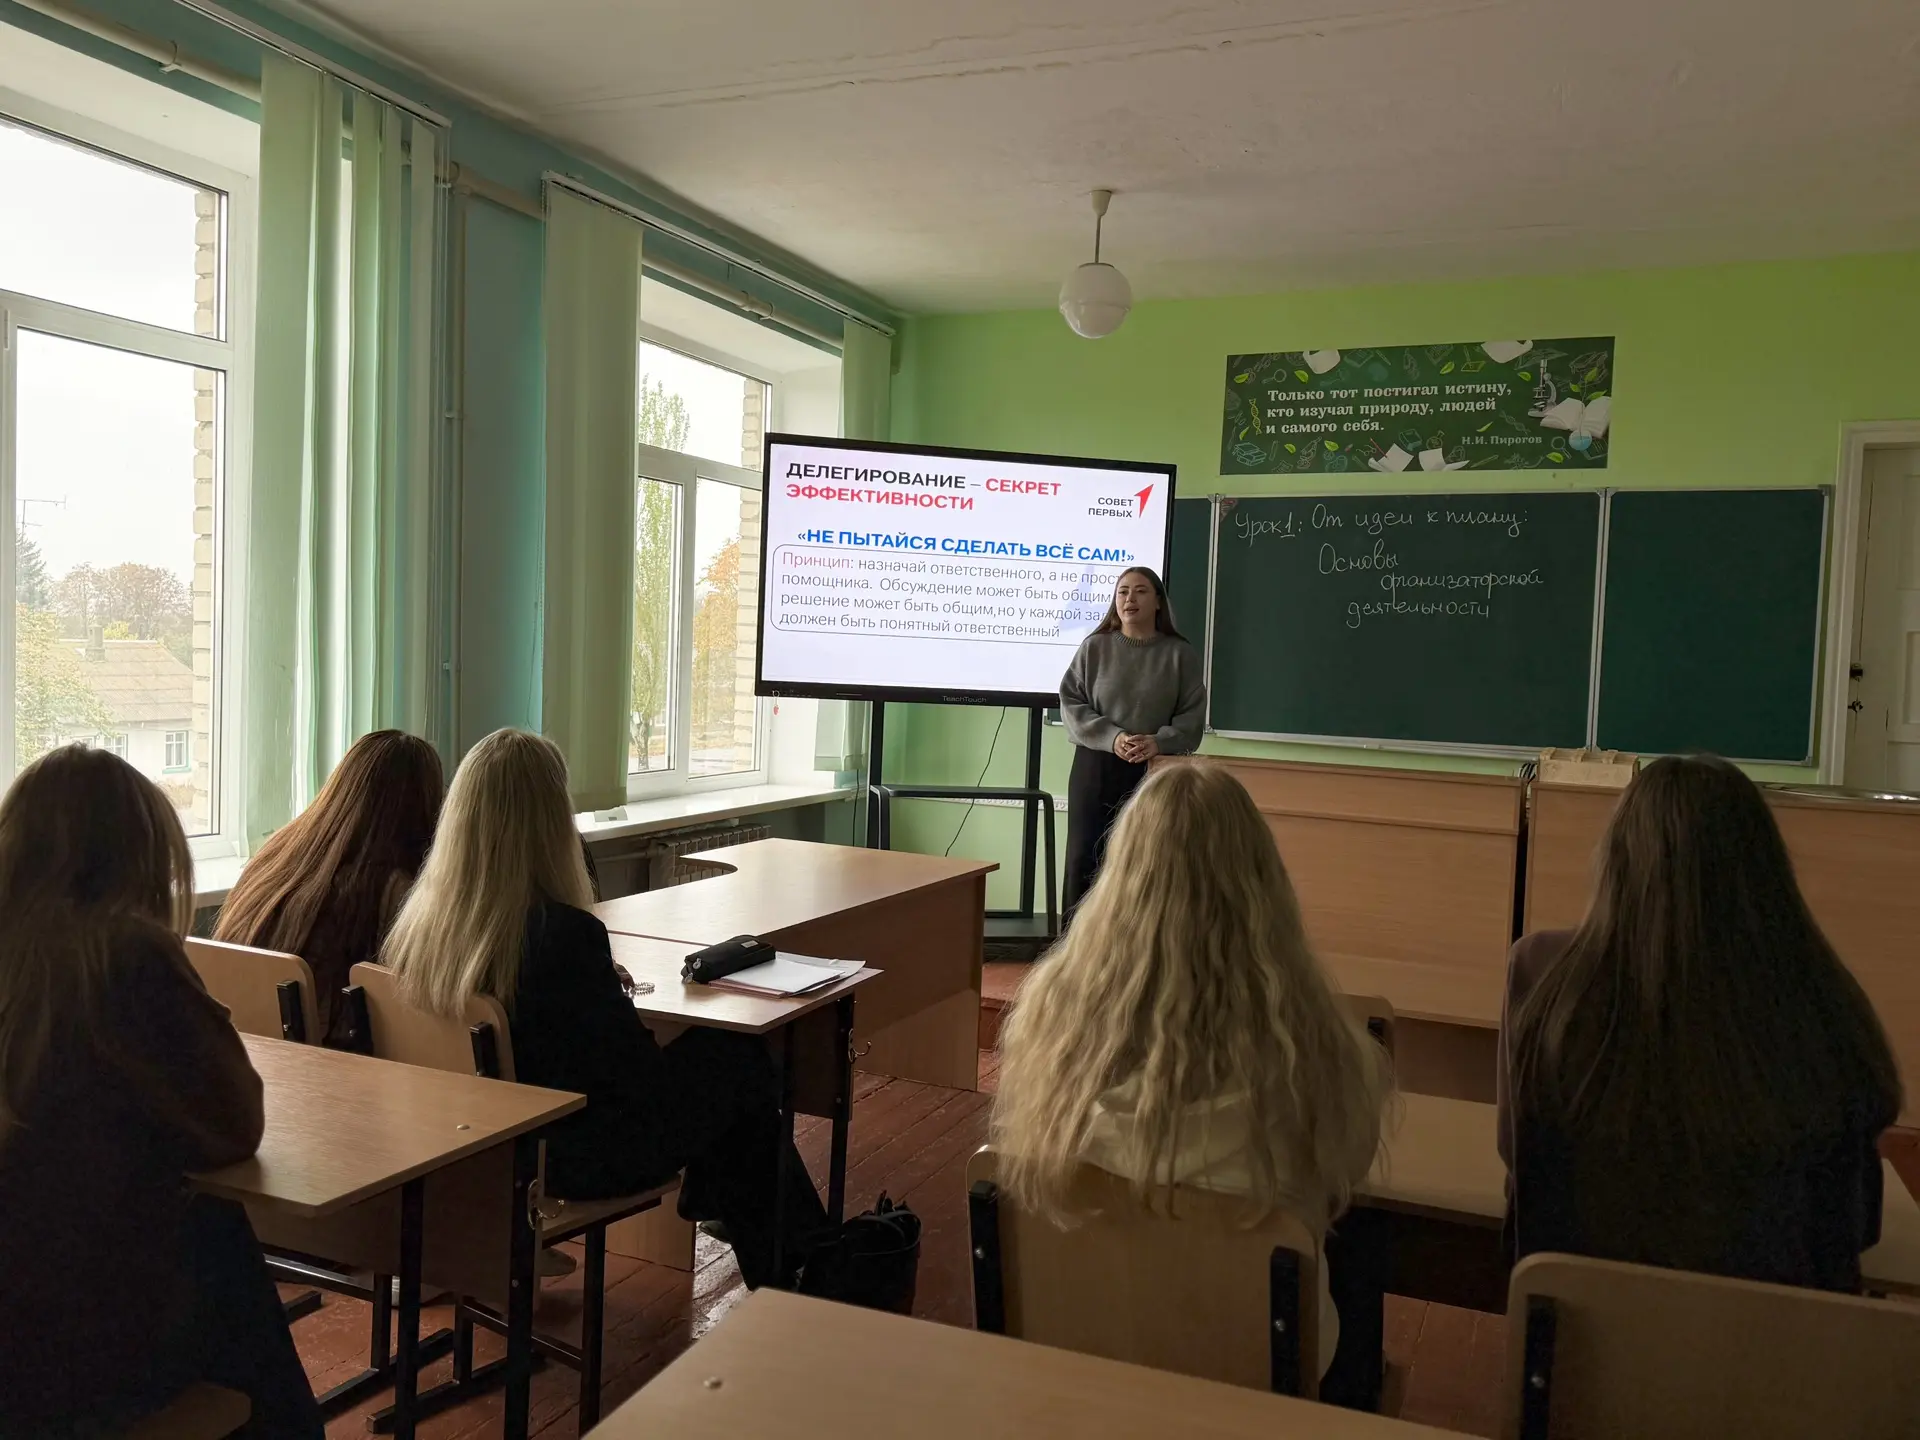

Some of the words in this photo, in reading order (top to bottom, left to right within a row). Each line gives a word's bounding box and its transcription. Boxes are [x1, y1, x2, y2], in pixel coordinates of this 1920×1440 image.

[1268, 389, 1325, 402] Только
[1330, 388, 1358, 399] тот
[1363, 385, 1439, 399] постигал
[1445, 382, 1512, 396] истину,
[1267, 407, 1294, 418] кто
[1300, 405, 1354, 419] изучал
[1360, 402, 1434, 417] природу,
[1440, 397, 1496, 413] людей
[1266, 424, 1276, 434] и
[1281, 422, 1337, 434] самого
[1343, 418, 1385, 432] себя.
[1490, 435, 1543, 447] Пирогов
[786, 462, 966, 489] ДЕЛЕГИРОВАНИЕ
[985, 477, 1062, 496] СЕКРЕТ
[786, 483, 974, 511] ЭФФЕКТИВНОСТИ
[1097, 496, 1134, 508] СОВЕТ
[1088, 507, 1133, 518] ПЕРВЫХ
[1312, 503, 1344, 528] От
[1355, 511, 1413, 535] идеи
[1427, 510, 1439, 523] к
[798, 529, 834, 544] «НЕ
[839, 531, 937, 550] ПЫТАЙСЯ
[941, 538, 1032, 556] СДЕЛАТЬ
[1036, 543, 1074, 559] ВСЁ
[1078, 546, 1135, 562] САМ!»
[1318, 538, 1400, 575] Основы
[782, 551, 854, 569] Принцип:
[858, 559, 926, 573] назначай
[930, 563, 1045, 582] ответственного,
[1049, 571, 1057, 581] а
[1061, 572, 1077, 582] не
[781, 574, 873, 590] помощника.
[880, 578, 972, 595] Обсуждение
[976, 586, 1021, 598] может
[1024, 586, 1058, 600] быть
[1062, 588, 1111, 604] общим
[1380, 569, 1544, 608] организаторской
[781, 593, 850, 607] решение
[854, 598, 901, 611] может
[904, 598, 939, 612] быть
[1018, 607, 1027, 619] у
[1029, 606, 1081, 621] каждой
[1346, 601, 1490, 629] деятельности
[779, 613, 836, 627] должен
[840, 614, 876, 628] быть
[880, 618, 950, 632] понятный
[954, 622, 1060, 638] ответственный
